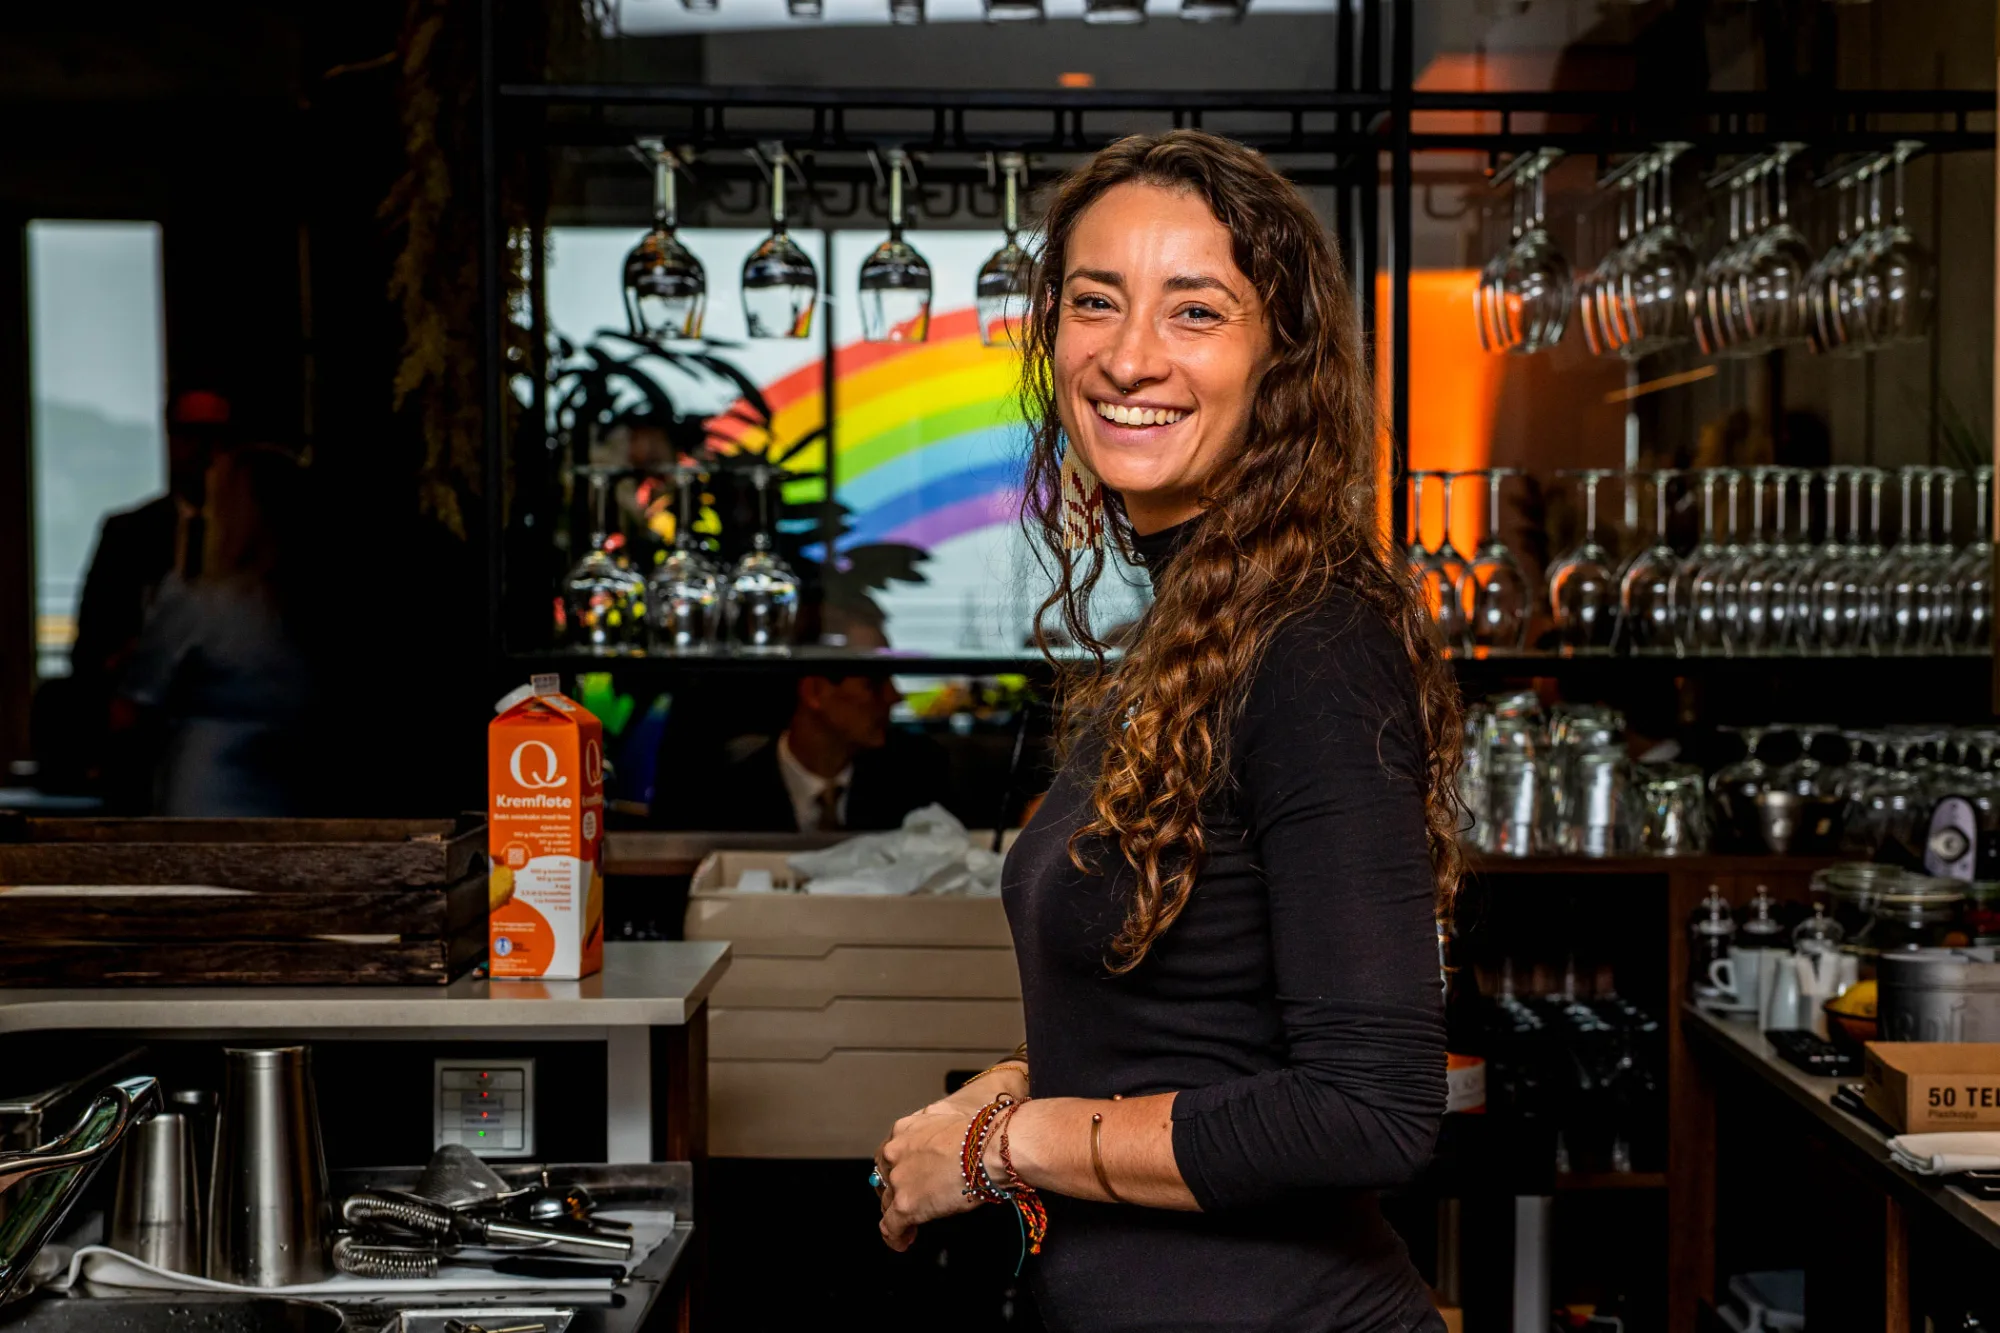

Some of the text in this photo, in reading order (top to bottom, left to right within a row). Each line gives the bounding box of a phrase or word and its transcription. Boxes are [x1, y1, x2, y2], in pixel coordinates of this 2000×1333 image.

[510, 740, 567, 789] Q
[495, 794, 573, 809] Kremfløte
[1928, 1087, 1957, 1107] 50
